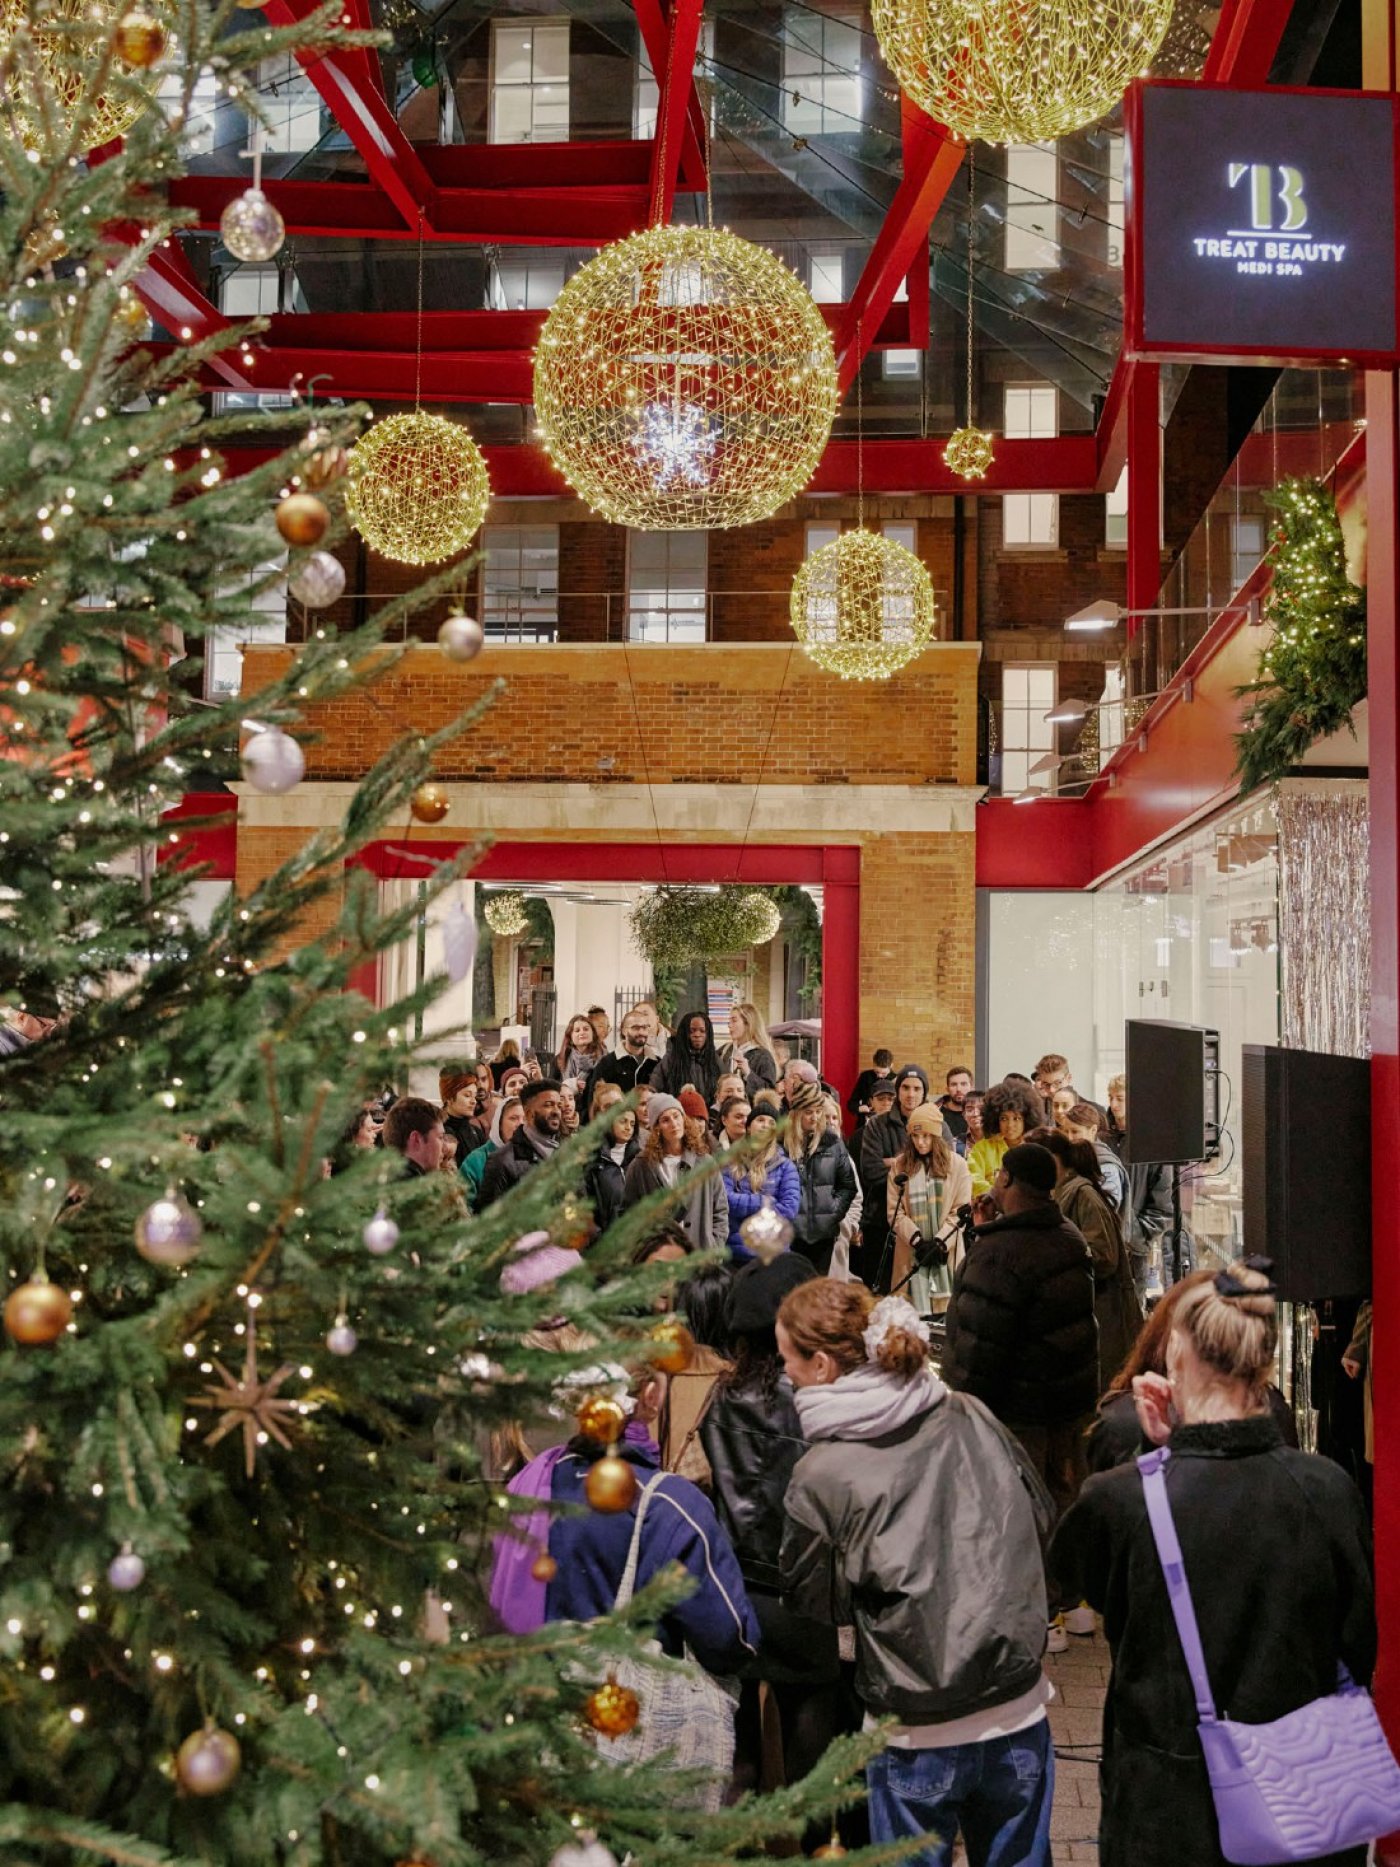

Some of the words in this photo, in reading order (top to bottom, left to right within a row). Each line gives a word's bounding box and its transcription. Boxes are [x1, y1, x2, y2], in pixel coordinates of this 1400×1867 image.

[1228, 162, 1308, 230] TB
[1193, 238, 1258, 259] TREAT
[1264, 241, 1346, 262] BEAUTY
[1237, 262, 1272, 274] MEDI
[1276, 263, 1303, 276] SPA
